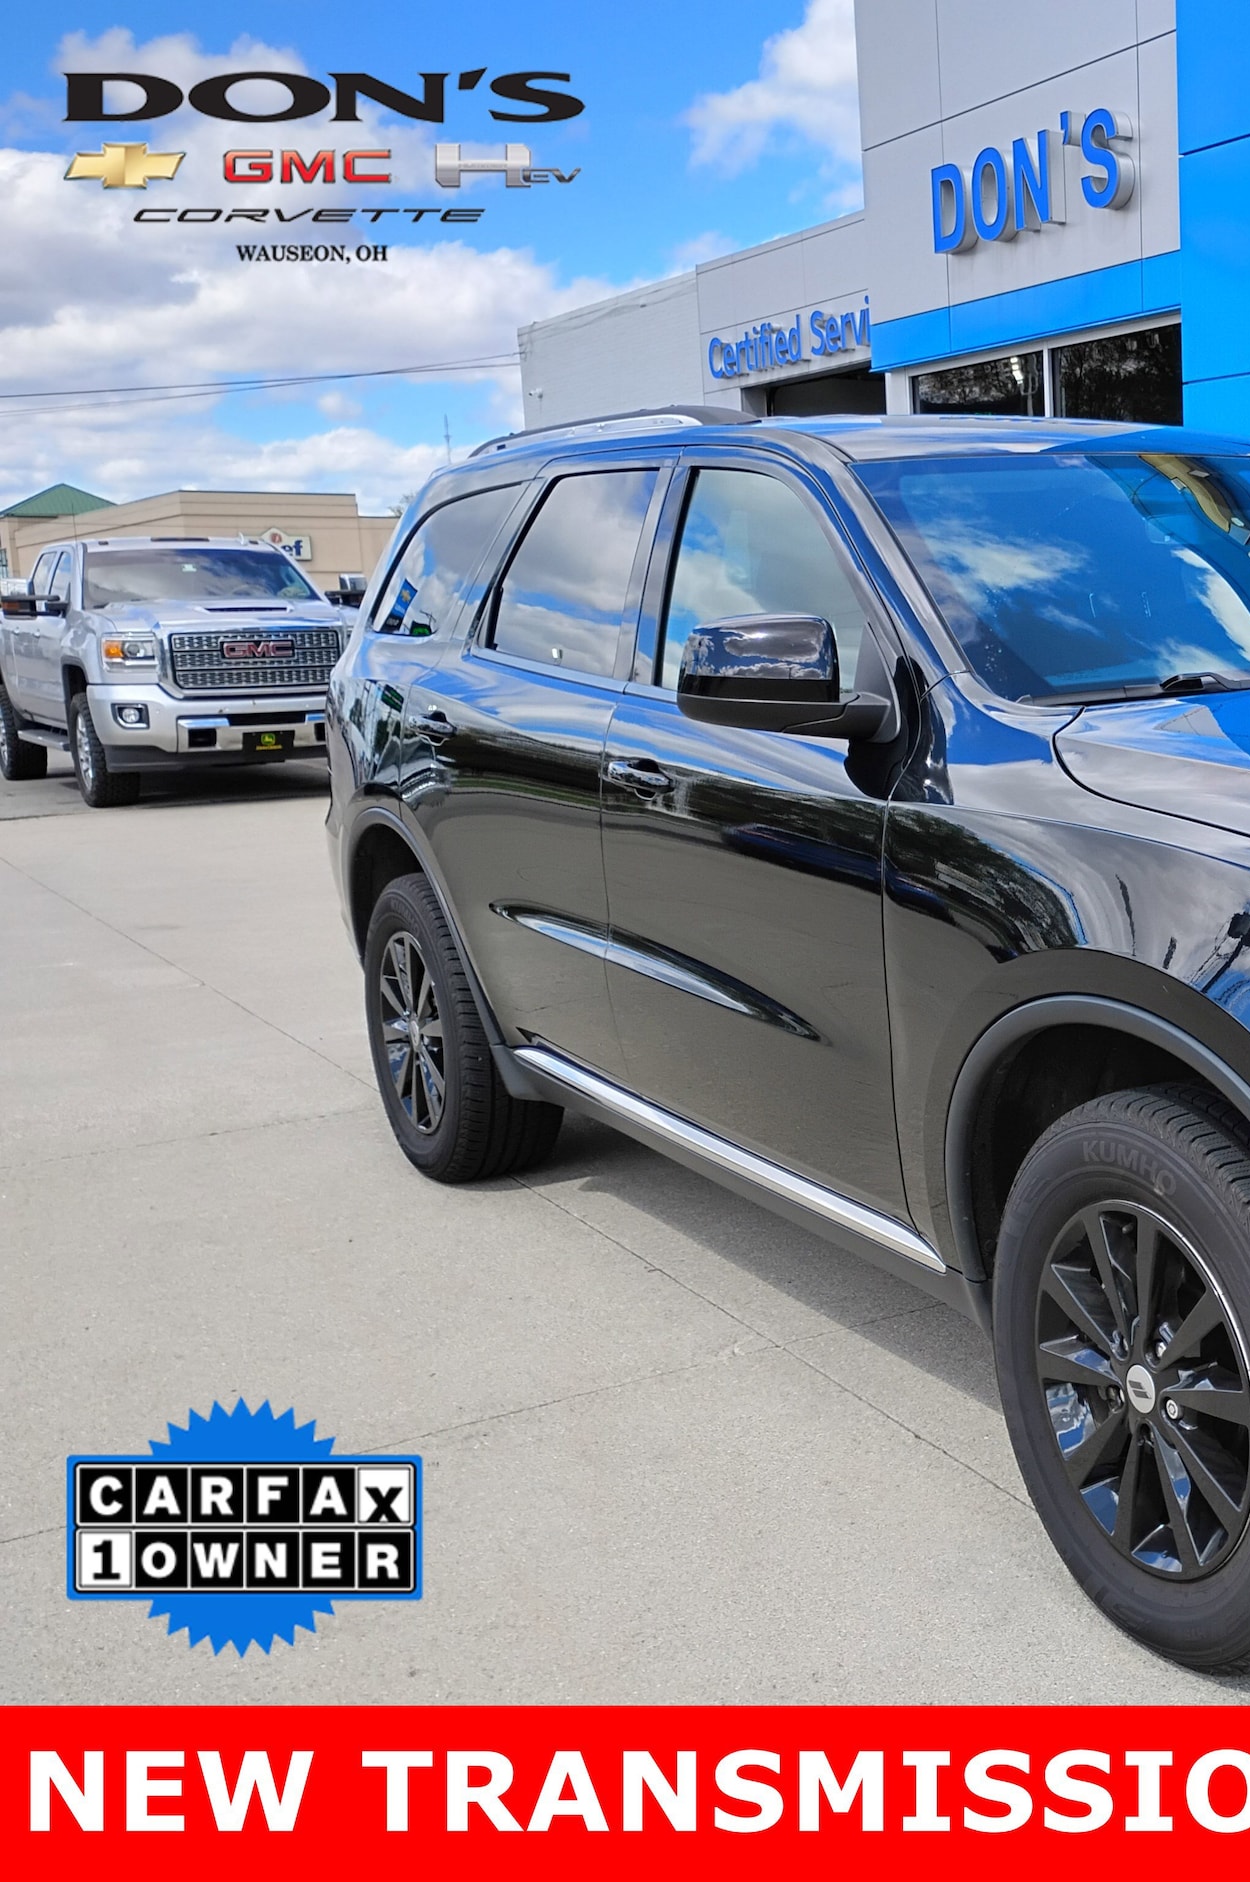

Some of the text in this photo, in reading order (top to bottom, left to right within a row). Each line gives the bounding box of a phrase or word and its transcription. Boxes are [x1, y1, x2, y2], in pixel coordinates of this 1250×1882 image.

[931, 108, 1121, 254] DON'S
[708, 313, 802, 379] Certified
[223, 640, 292, 658] GMC
[1082, 1140, 1177, 1196] KUMHO
